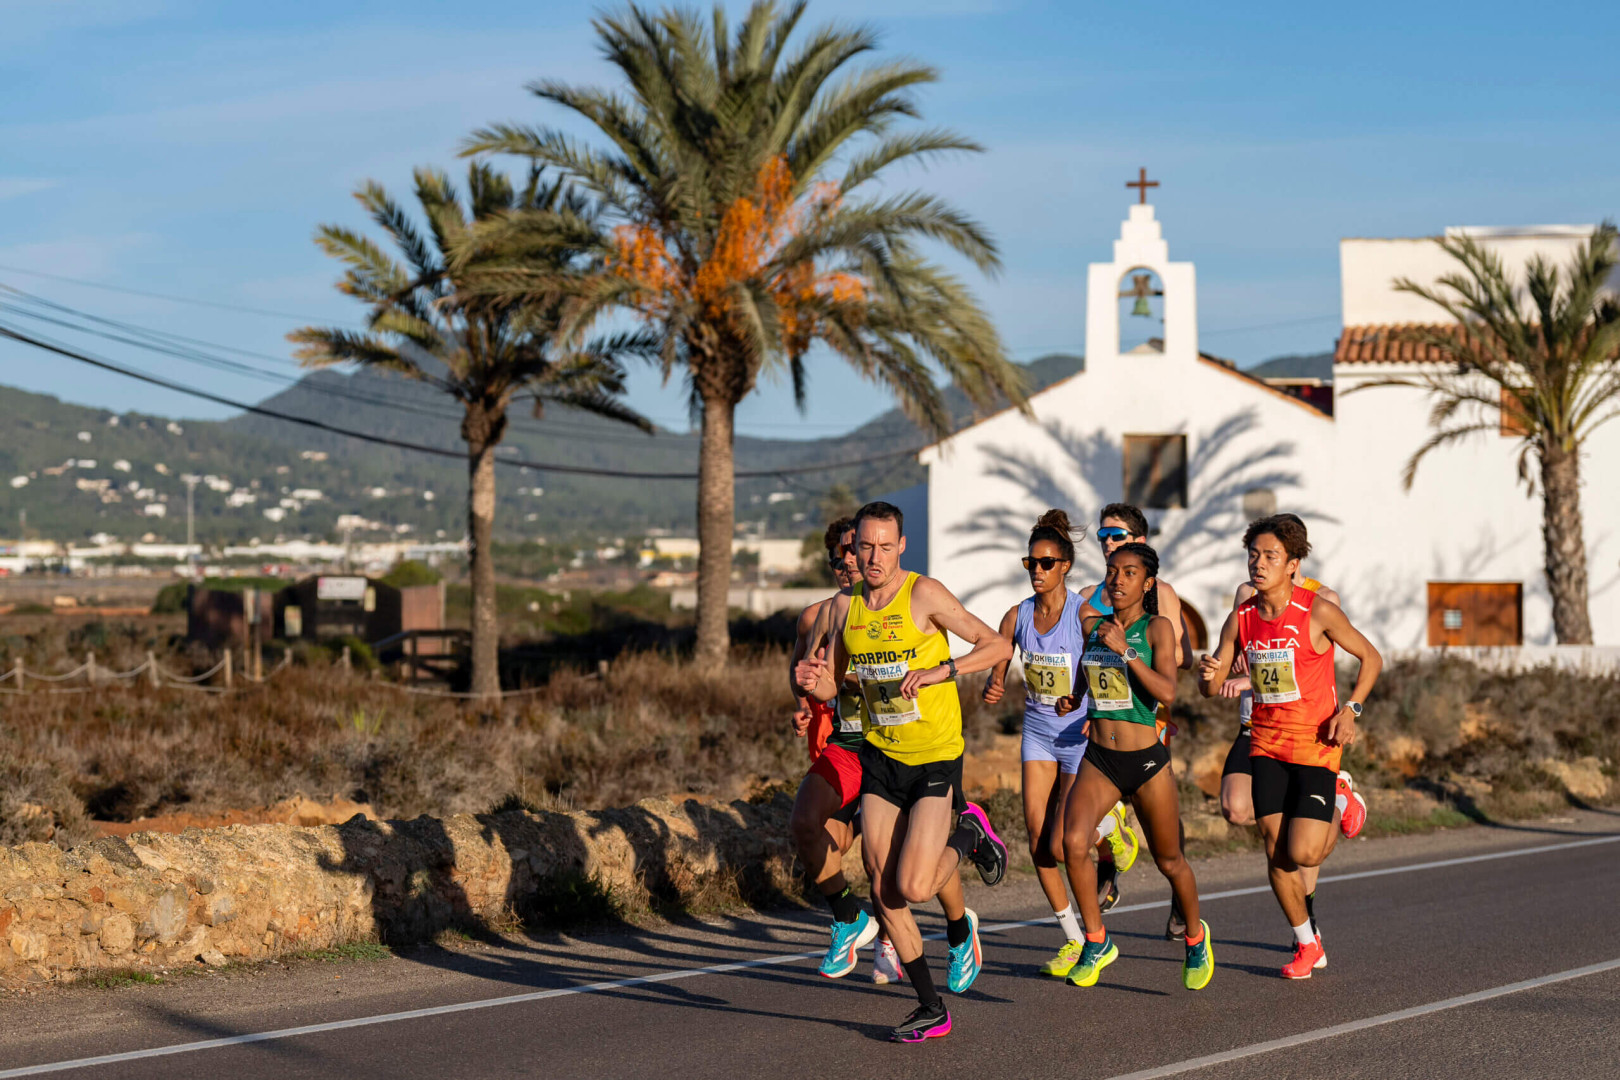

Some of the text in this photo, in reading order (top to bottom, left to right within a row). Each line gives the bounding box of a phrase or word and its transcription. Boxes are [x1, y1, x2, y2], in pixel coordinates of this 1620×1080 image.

[1244, 637, 1301, 652] ANTA
[852, 648, 917, 665] CORPIO-71
[1038, 670, 1055, 687] 13
[1098, 672, 1108, 690] 6
[1261, 667, 1279, 685] 24
[879, 686, 890, 704] 8
